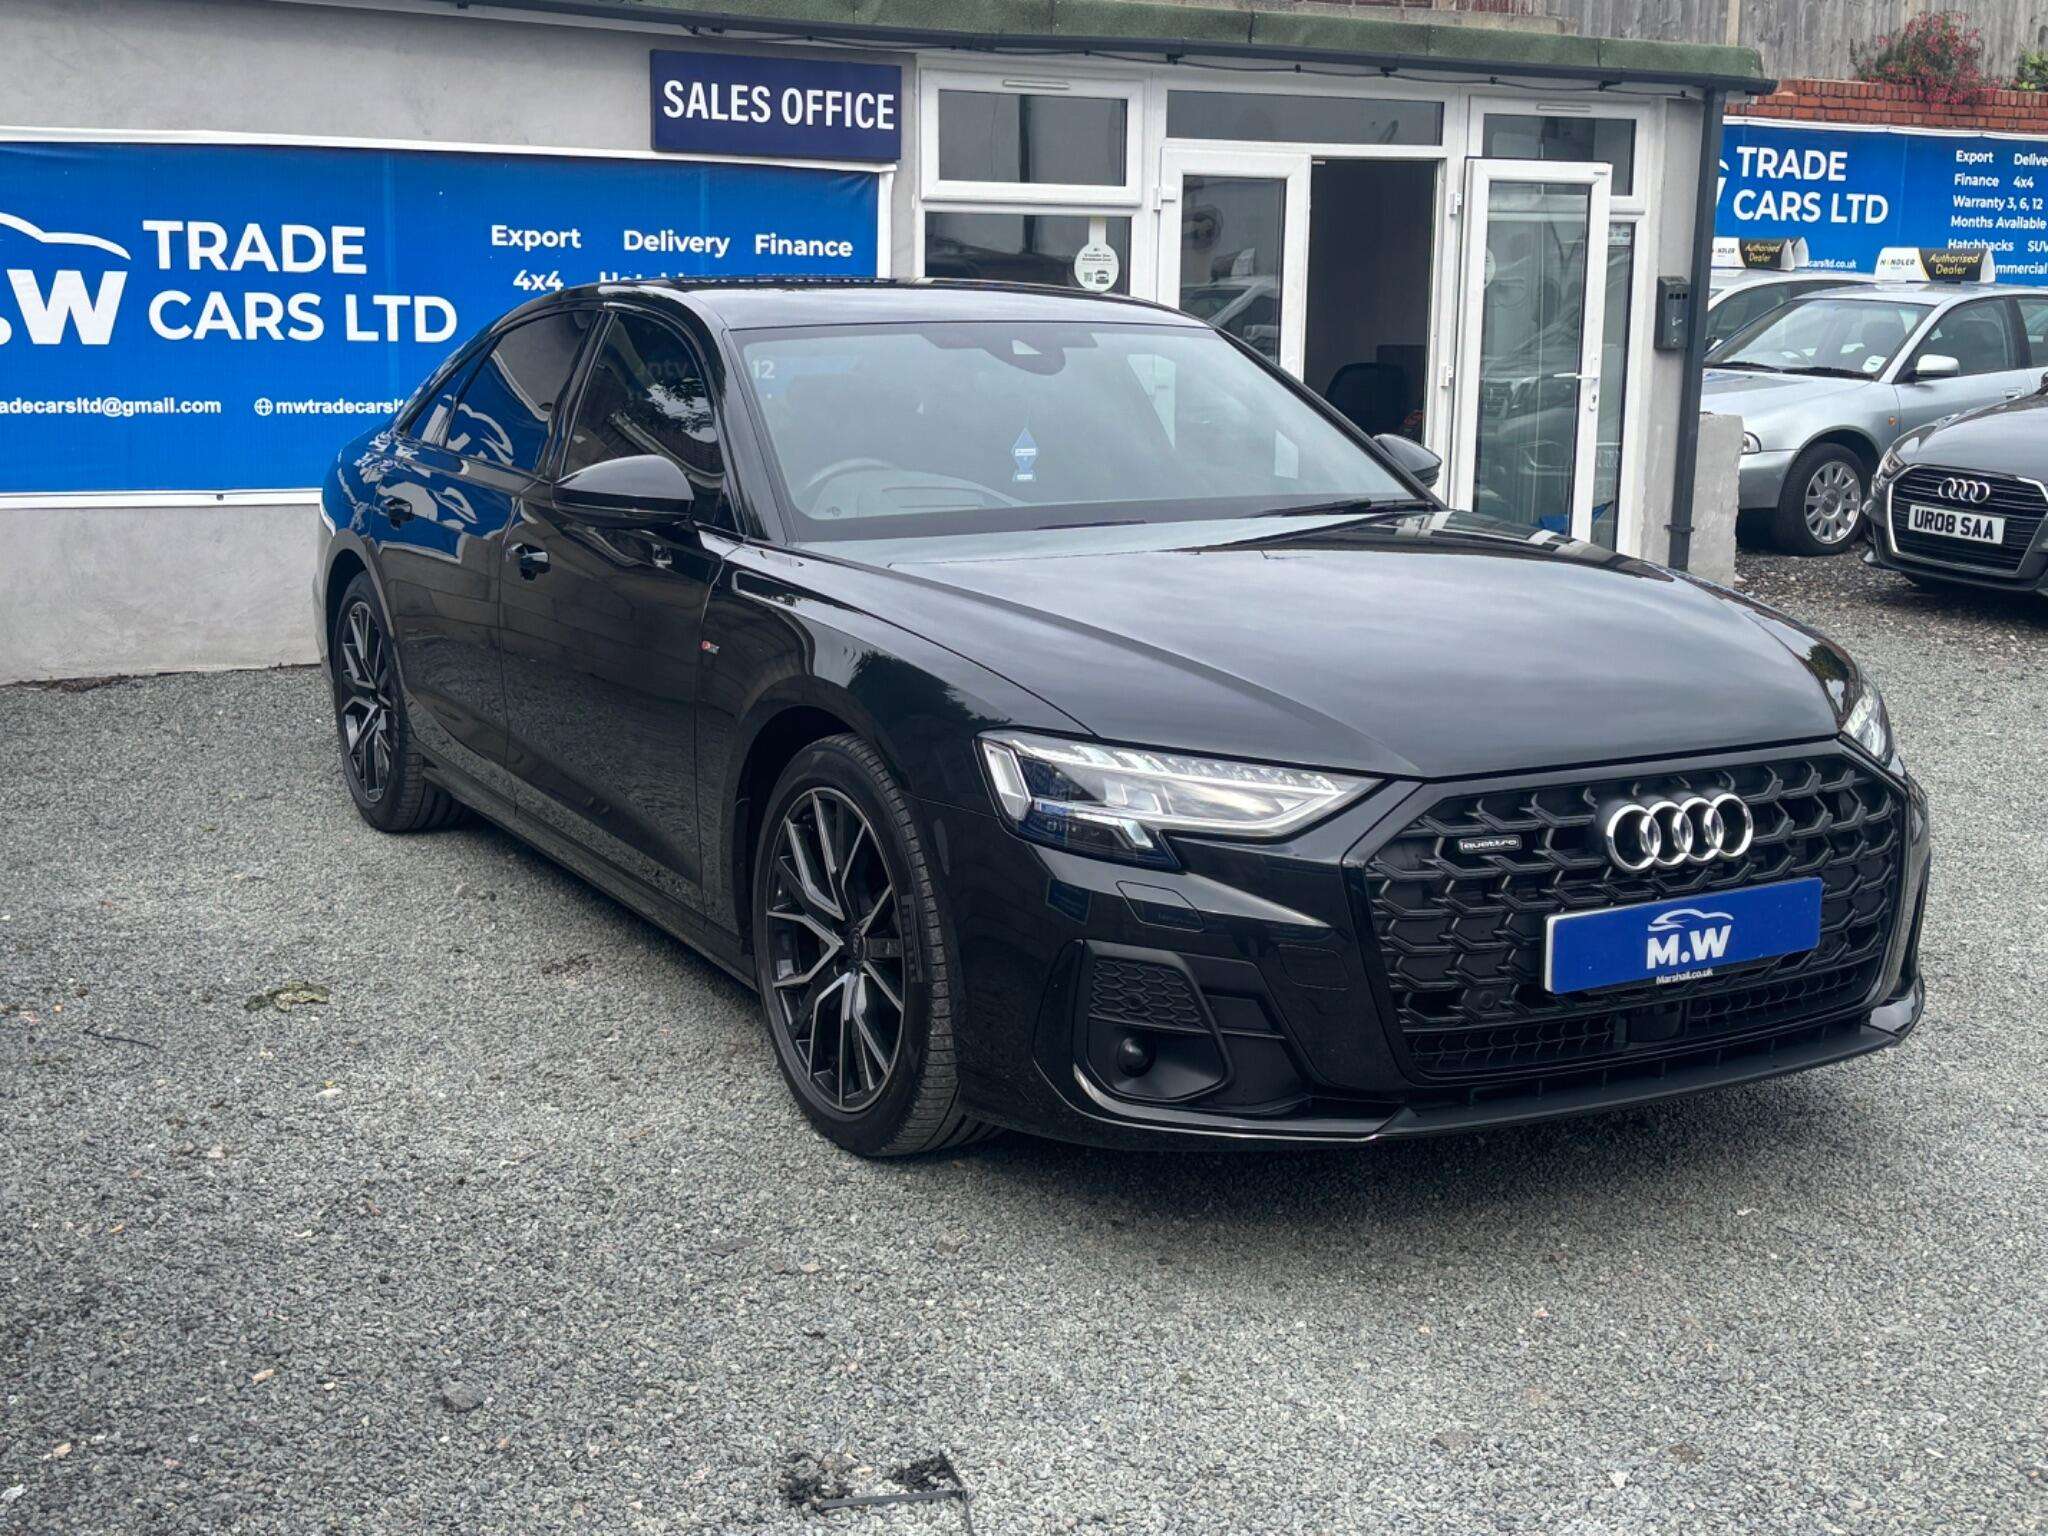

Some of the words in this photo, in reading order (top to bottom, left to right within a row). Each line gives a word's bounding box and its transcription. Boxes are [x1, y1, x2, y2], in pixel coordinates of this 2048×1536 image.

[663, 80, 771, 123] SALES
[781, 86, 895, 131] OFFICE
[1736, 145, 1848, 182] TRADE
[1955, 150, 1994, 165] Export
[1954, 172, 2000, 188] Finance
[2013, 175, 2034, 189] 4x4
[1733, 188, 1821, 223] CARS
[1830, 193, 1889, 225] LTD
[1952, 195, 2006, 211] Warranty
[2007, 197, 2017, 211] 3,
[2019, 197, 2029, 211] 6,
[2032, 197, 2043, 210] 12
[1951, 215, 1994, 229] Months
[1995, 216, 2048, 230] Available
[142, 220, 367, 275] TRADE
[491, 224, 582, 252] Export
[623, 230, 731, 258] Delivery
[755, 234, 854, 257] Finance
[512, 269, 564, 292] 4x4
[1935, 263, 1967, 275] Dealer
[148, 290, 323, 341] CARS
[346, 294, 457, 344] LTD
[1914, 509, 1956, 533] UR08
[1960, 517, 1994, 540] SAA
[1646, 925, 1732, 970] M.W
[1656, 967, 1714, 985] Marshall.co.uk
